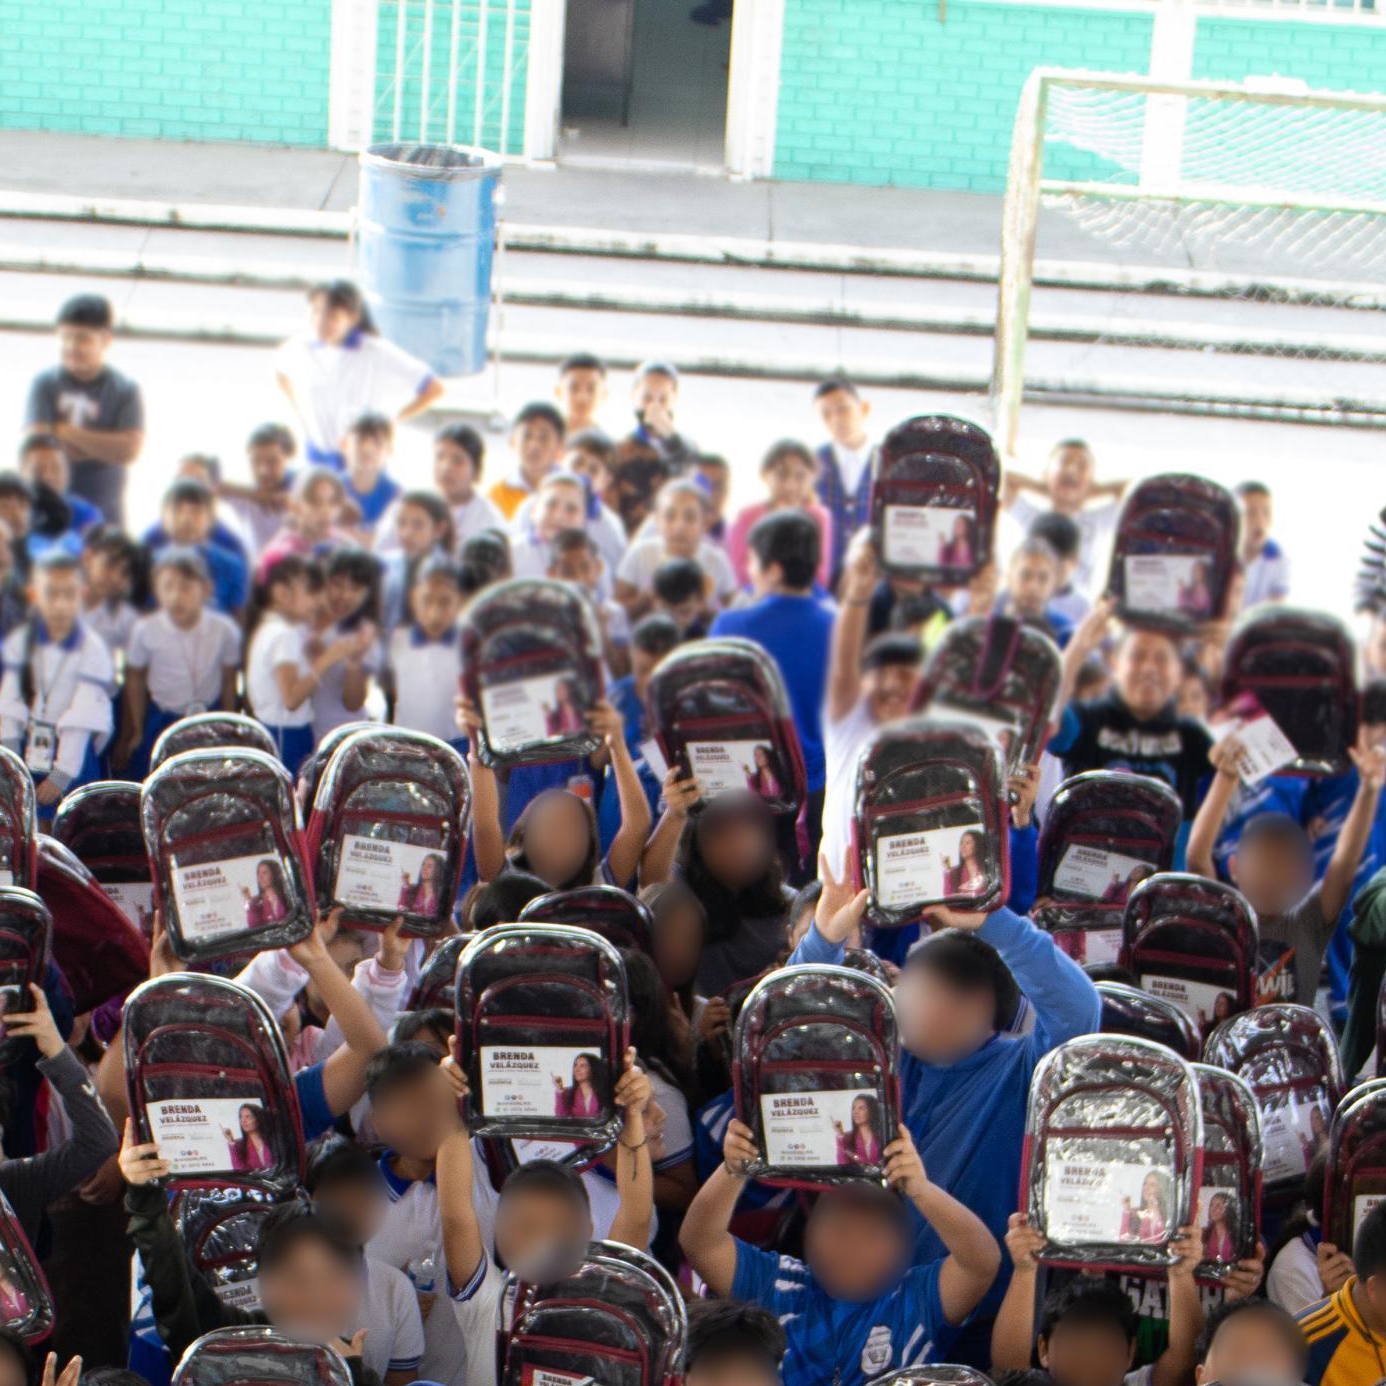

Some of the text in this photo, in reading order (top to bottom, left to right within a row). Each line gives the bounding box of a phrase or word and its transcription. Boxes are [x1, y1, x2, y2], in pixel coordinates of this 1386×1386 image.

[354, 841, 390, 854] BRENDA
[889, 838, 925, 849] BRENDA
[184, 867, 222, 881] BRENDA
[1152, 980, 1185, 992] BRENDA
[493, 1052, 534, 1060] BRENDA
[774, 1097, 814, 1107] BRENDA
[161, 1106, 201, 1115] BRENDA
[771, 1108, 818, 1117] VELÁZQUEZ
[542, 1374, 572, 1386] BRENDA
